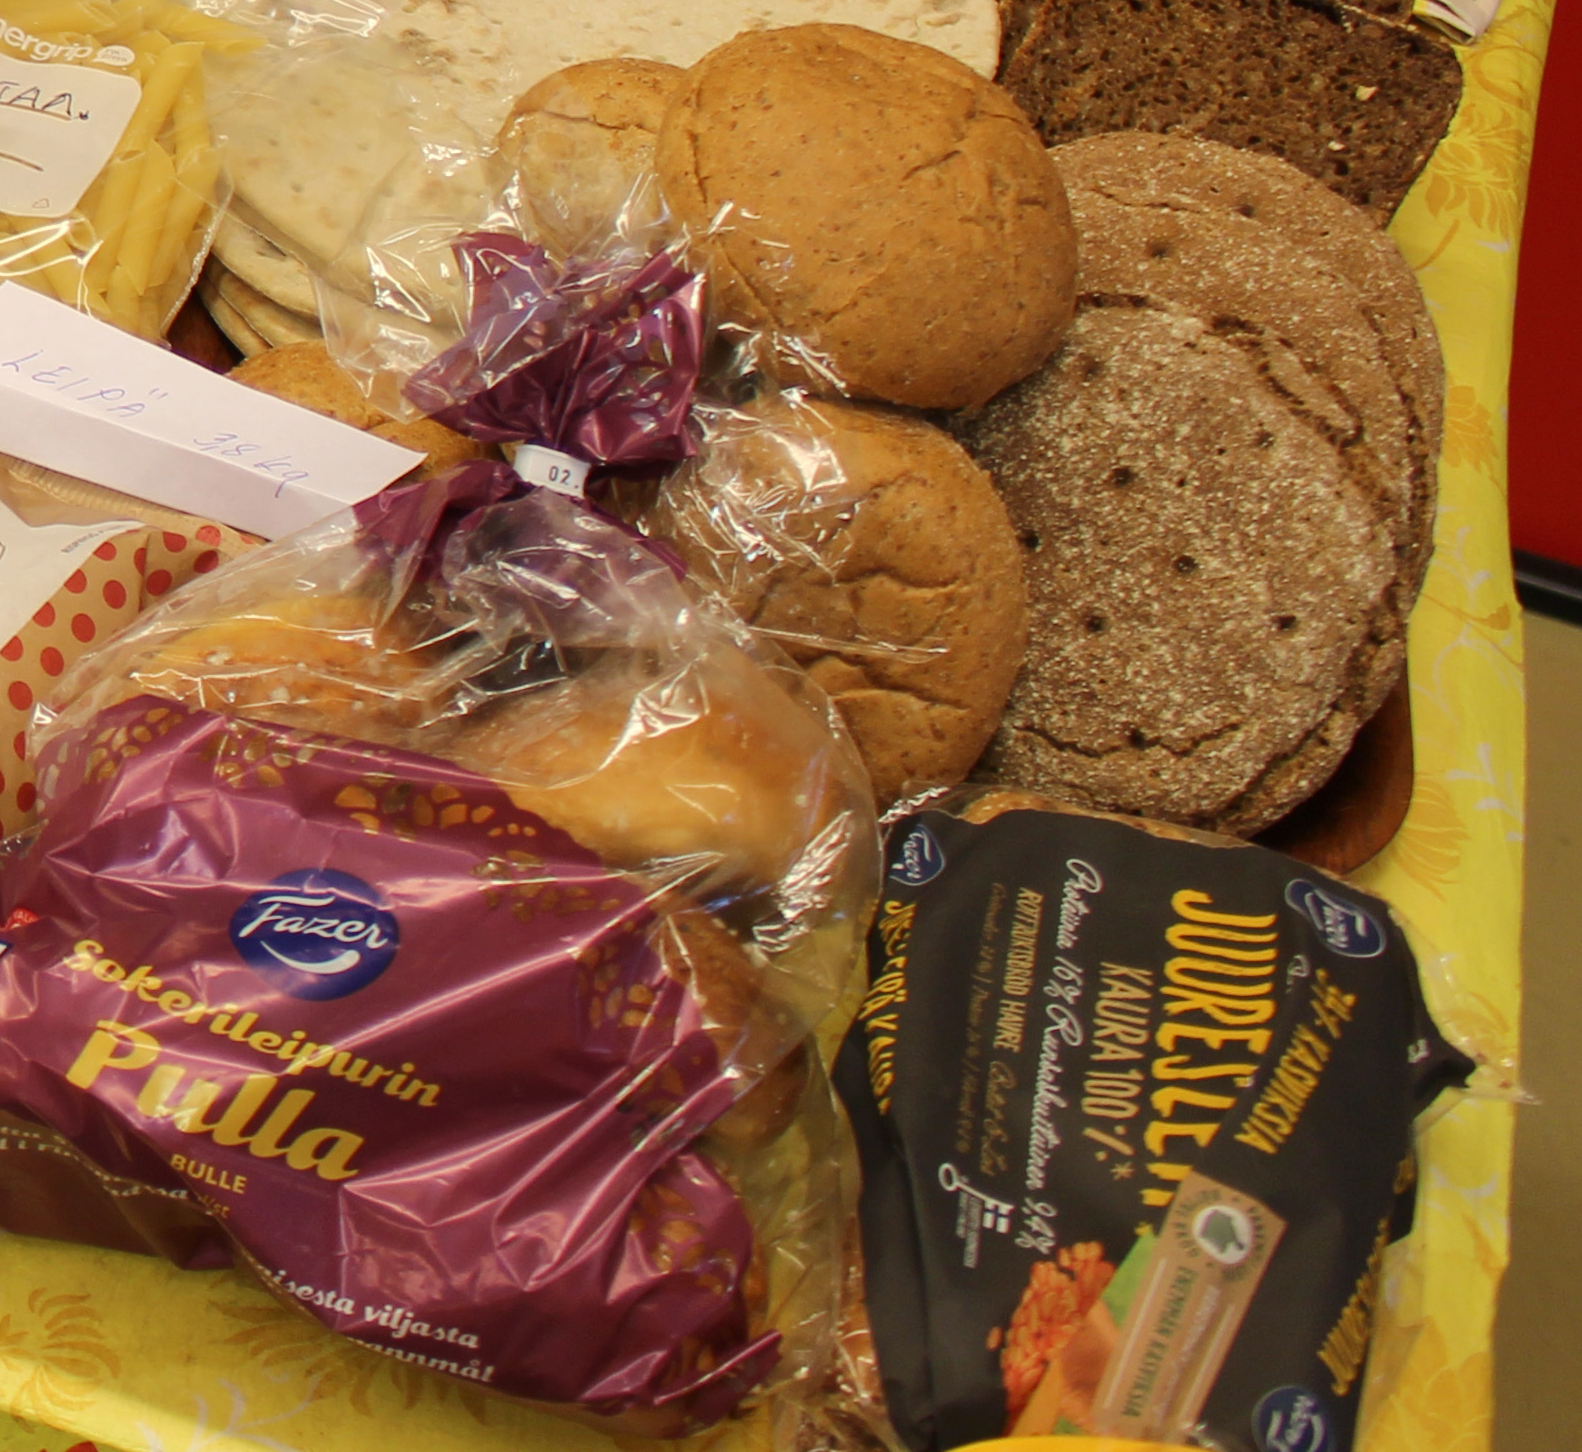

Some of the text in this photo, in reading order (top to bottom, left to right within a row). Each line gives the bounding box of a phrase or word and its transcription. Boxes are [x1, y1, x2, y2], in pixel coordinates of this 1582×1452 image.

[236, 890, 390, 953] Fazer
[62, 938, 442, 1110] Sokerileipurin
[1091, 960, 1155, 1063] KAURA
[1140, 888, 1279, 1208] JUURESLEI
[64, 1018, 362, 1184] Pulla
[169, 1153, 248, 1196] BULLE
[361, 1300, 482, 1351] viljasta
